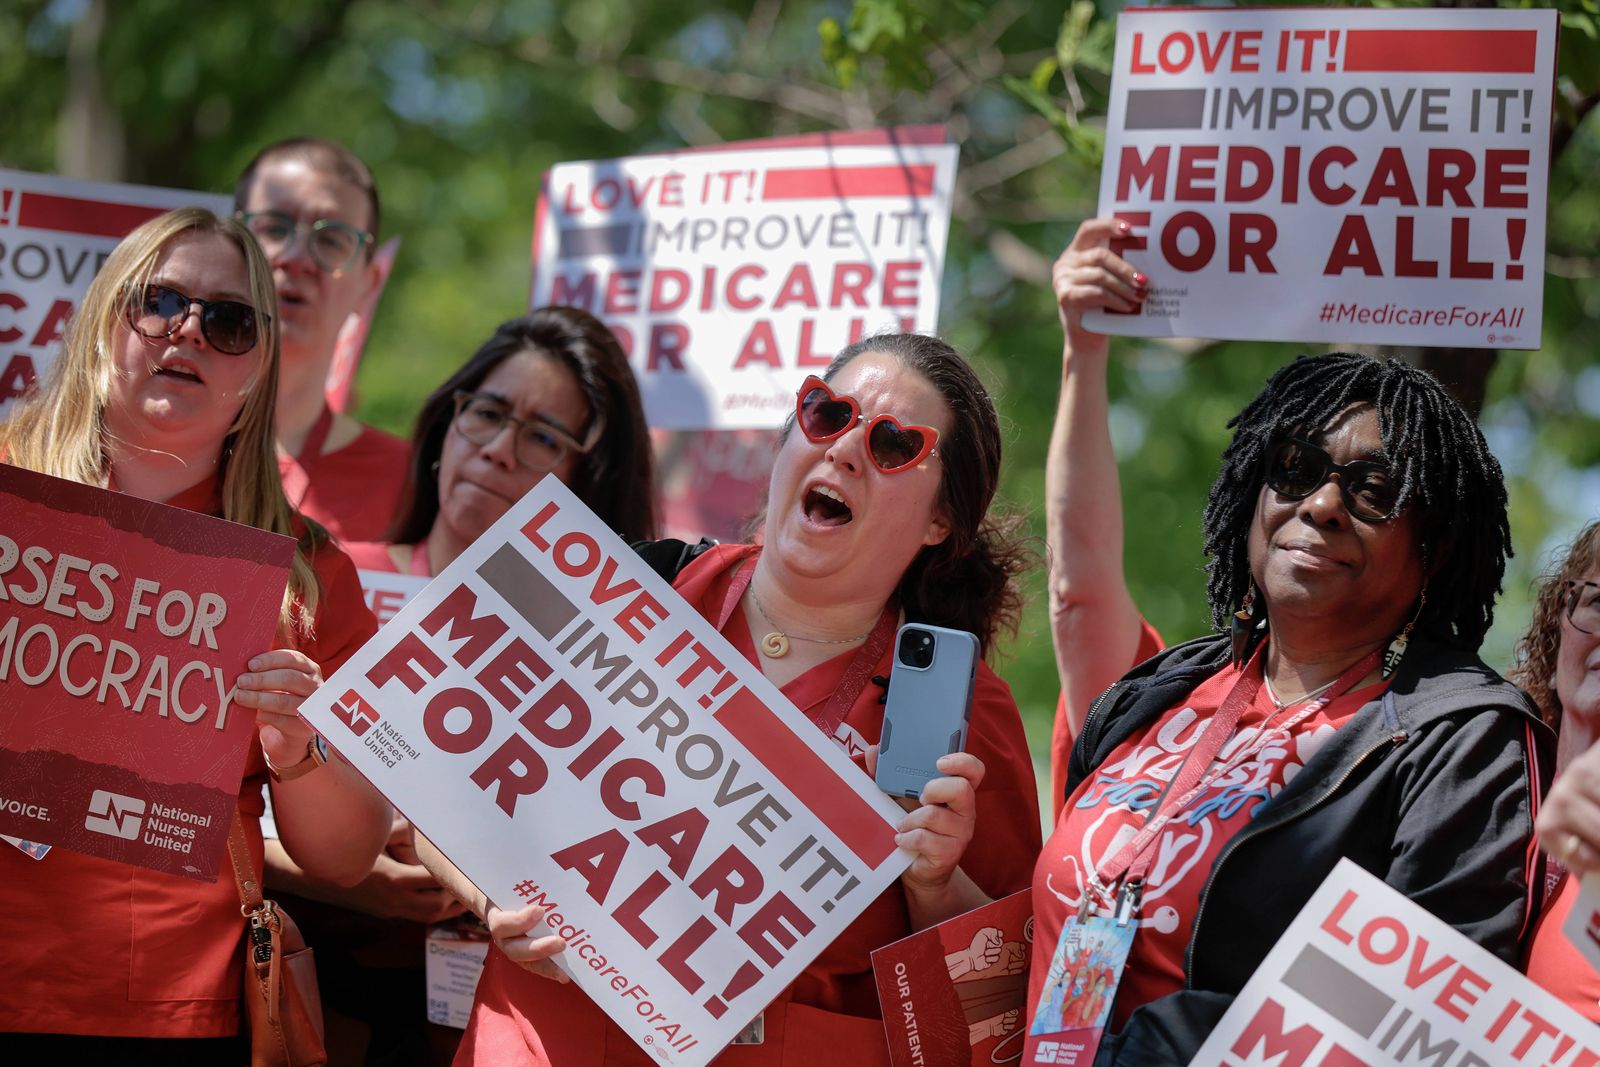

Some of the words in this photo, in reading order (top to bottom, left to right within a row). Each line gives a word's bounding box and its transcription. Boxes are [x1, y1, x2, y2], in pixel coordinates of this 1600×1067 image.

[1130, 30, 1263, 75] LOVE
[1276, 29, 1341, 74] IT!
[1209, 87, 1450, 132] IMPROVE
[1469, 89, 1534, 134] IT!
[563, 173, 685, 216] LOVE
[700, 169, 757, 205] IT!
[1114, 145, 1530, 209] MEDICARE
[630, 212, 855, 256] IMPROVE
[872, 210, 930, 247] IT!
[1109, 211, 1278, 275] FOR
[1323, 215, 1527, 281] ALL!
[549, 261, 923, 316] MEDICARE
[1319, 303, 1525, 328] #MedicareForAll
[124, 578, 228, 651] FOR
[520, 501, 671, 644] LOVE
[655, 631, 738, 709] IT!
[364, 736, 397, 768] United
[372, 728, 404, 761] Nurses
[380, 721, 421, 760] National
[419, 583, 817, 969] MEDICARE
[556, 618, 793, 847] IMPROVE
[780, 835, 862, 914] IT!
[147, 817, 196, 839] Nurses
[150, 803, 212, 828] National
[365, 631, 550, 819] FOR
[551, 828, 765, 1020] ALL!
[143, 832, 193, 854] United
[513, 879, 699, 1053] #MedicareForAll
[895, 963, 911, 998] OUR
[1319, 889, 1492, 1023] LOVE
[1484, 998, 1577, 1067] IT!
[902, 1001, 925, 1067] PATIENT
